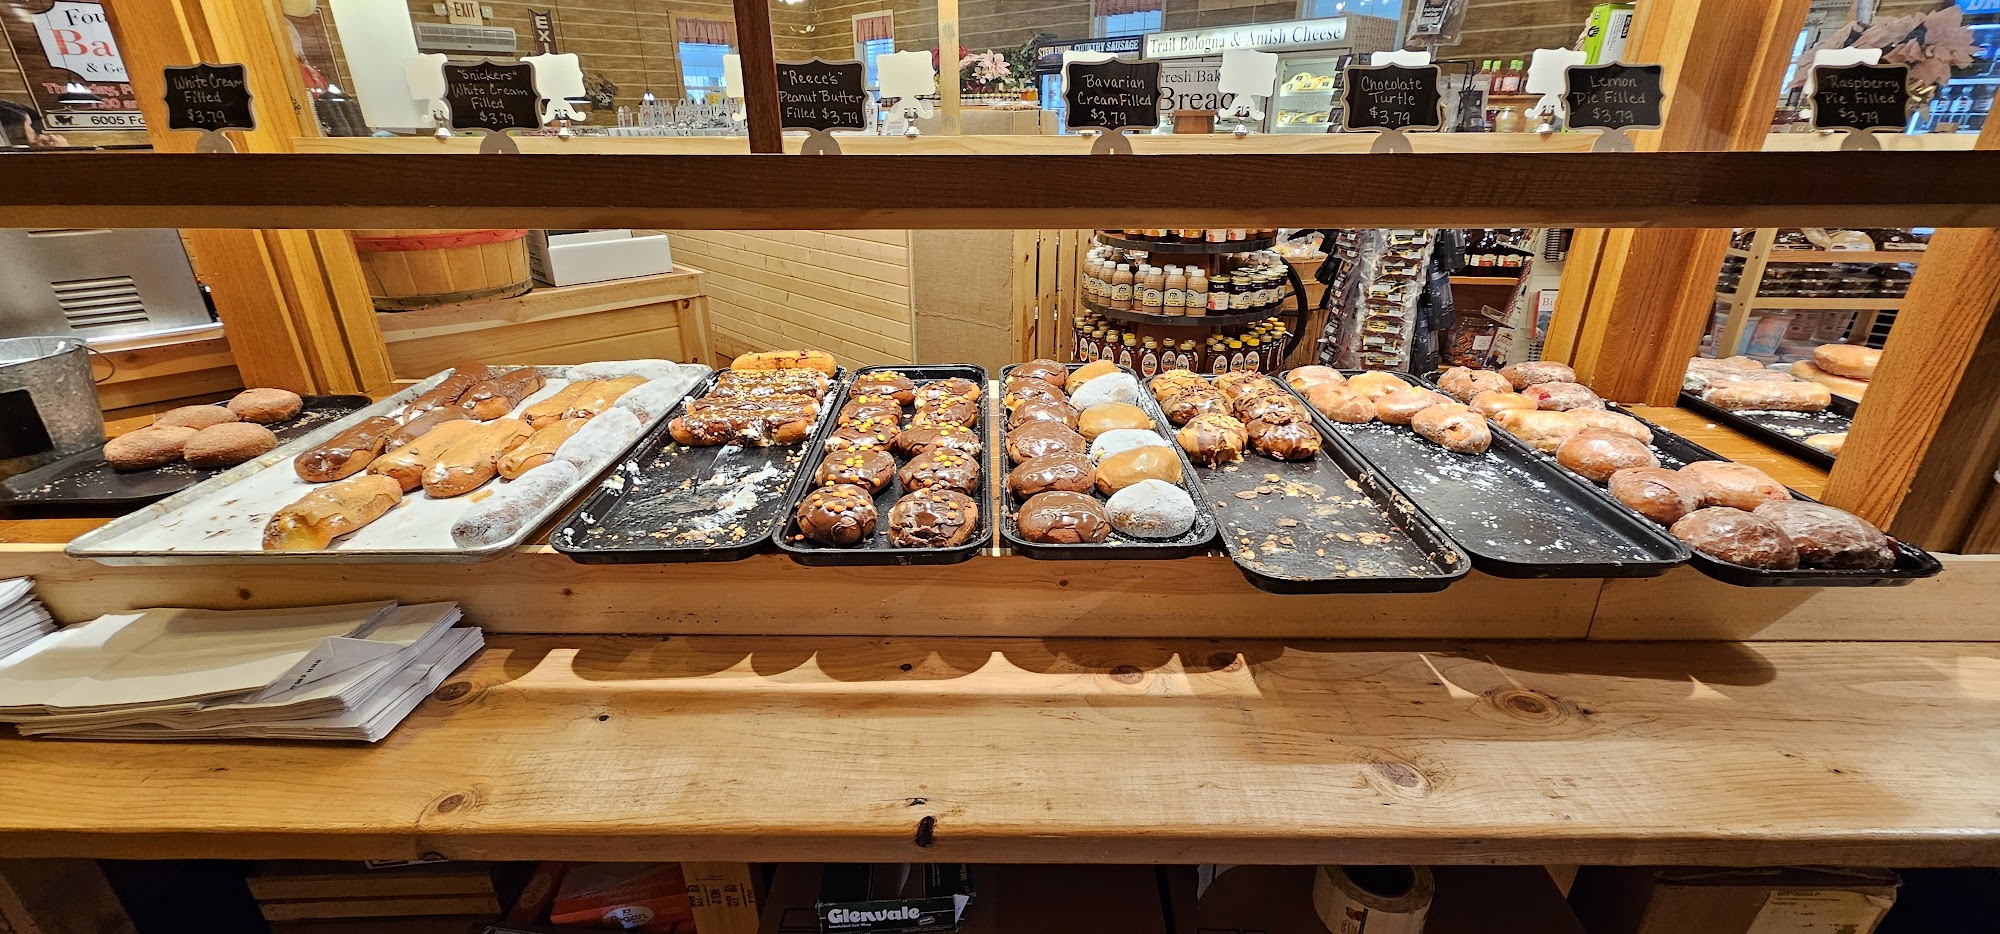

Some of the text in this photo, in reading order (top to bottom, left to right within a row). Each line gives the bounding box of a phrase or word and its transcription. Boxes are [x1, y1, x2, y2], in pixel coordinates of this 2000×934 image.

[454, 2, 476, 18] EXIT
[47, 28, 114, 57] Ba
[1106, 39, 1139, 52] SAUSAGE
[1150, 23, 1341, 53] Trail Bologna & Amish Cheese
[86, 63, 99, 73] &
[174, 73, 243, 90] White Cream
[1082, 74, 1145, 89] Bavarian
[1361, 76, 1423, 91] Chocolate
[1590, 75, 1638, 88] Lemon
[1826, 74, 1900, 93] Raspberry
[184, 89, 222, 103] Filled
[450, 82, 528, 98] White Cream
[778, 90, 863, 104] Peanut Butter
[1368, 90, 1416, 106] Turtle
[1572, 91, 1646, 105] Pie Filled
[1820, 91, 1896, 104] Pie Filled
[471, 97, 504, 110] Filled
[1077, 91, 1152, 107] Cream Filled
[91, 116, 124, 125] 6005
[187, 108, 227, 124] $3.79
[479, 110, 515, 125] $3.79
[786, 106, 859, 124] Filled $3.79
[1090, 107, 1127, 126] $3.79
[1369, 106, 1411, 125] $3.79
[1592, 107, 1634, 123] $3.79
[1838, 107, 1879, 124] $3.79
[828, 906, 920, 923] Glenvale
